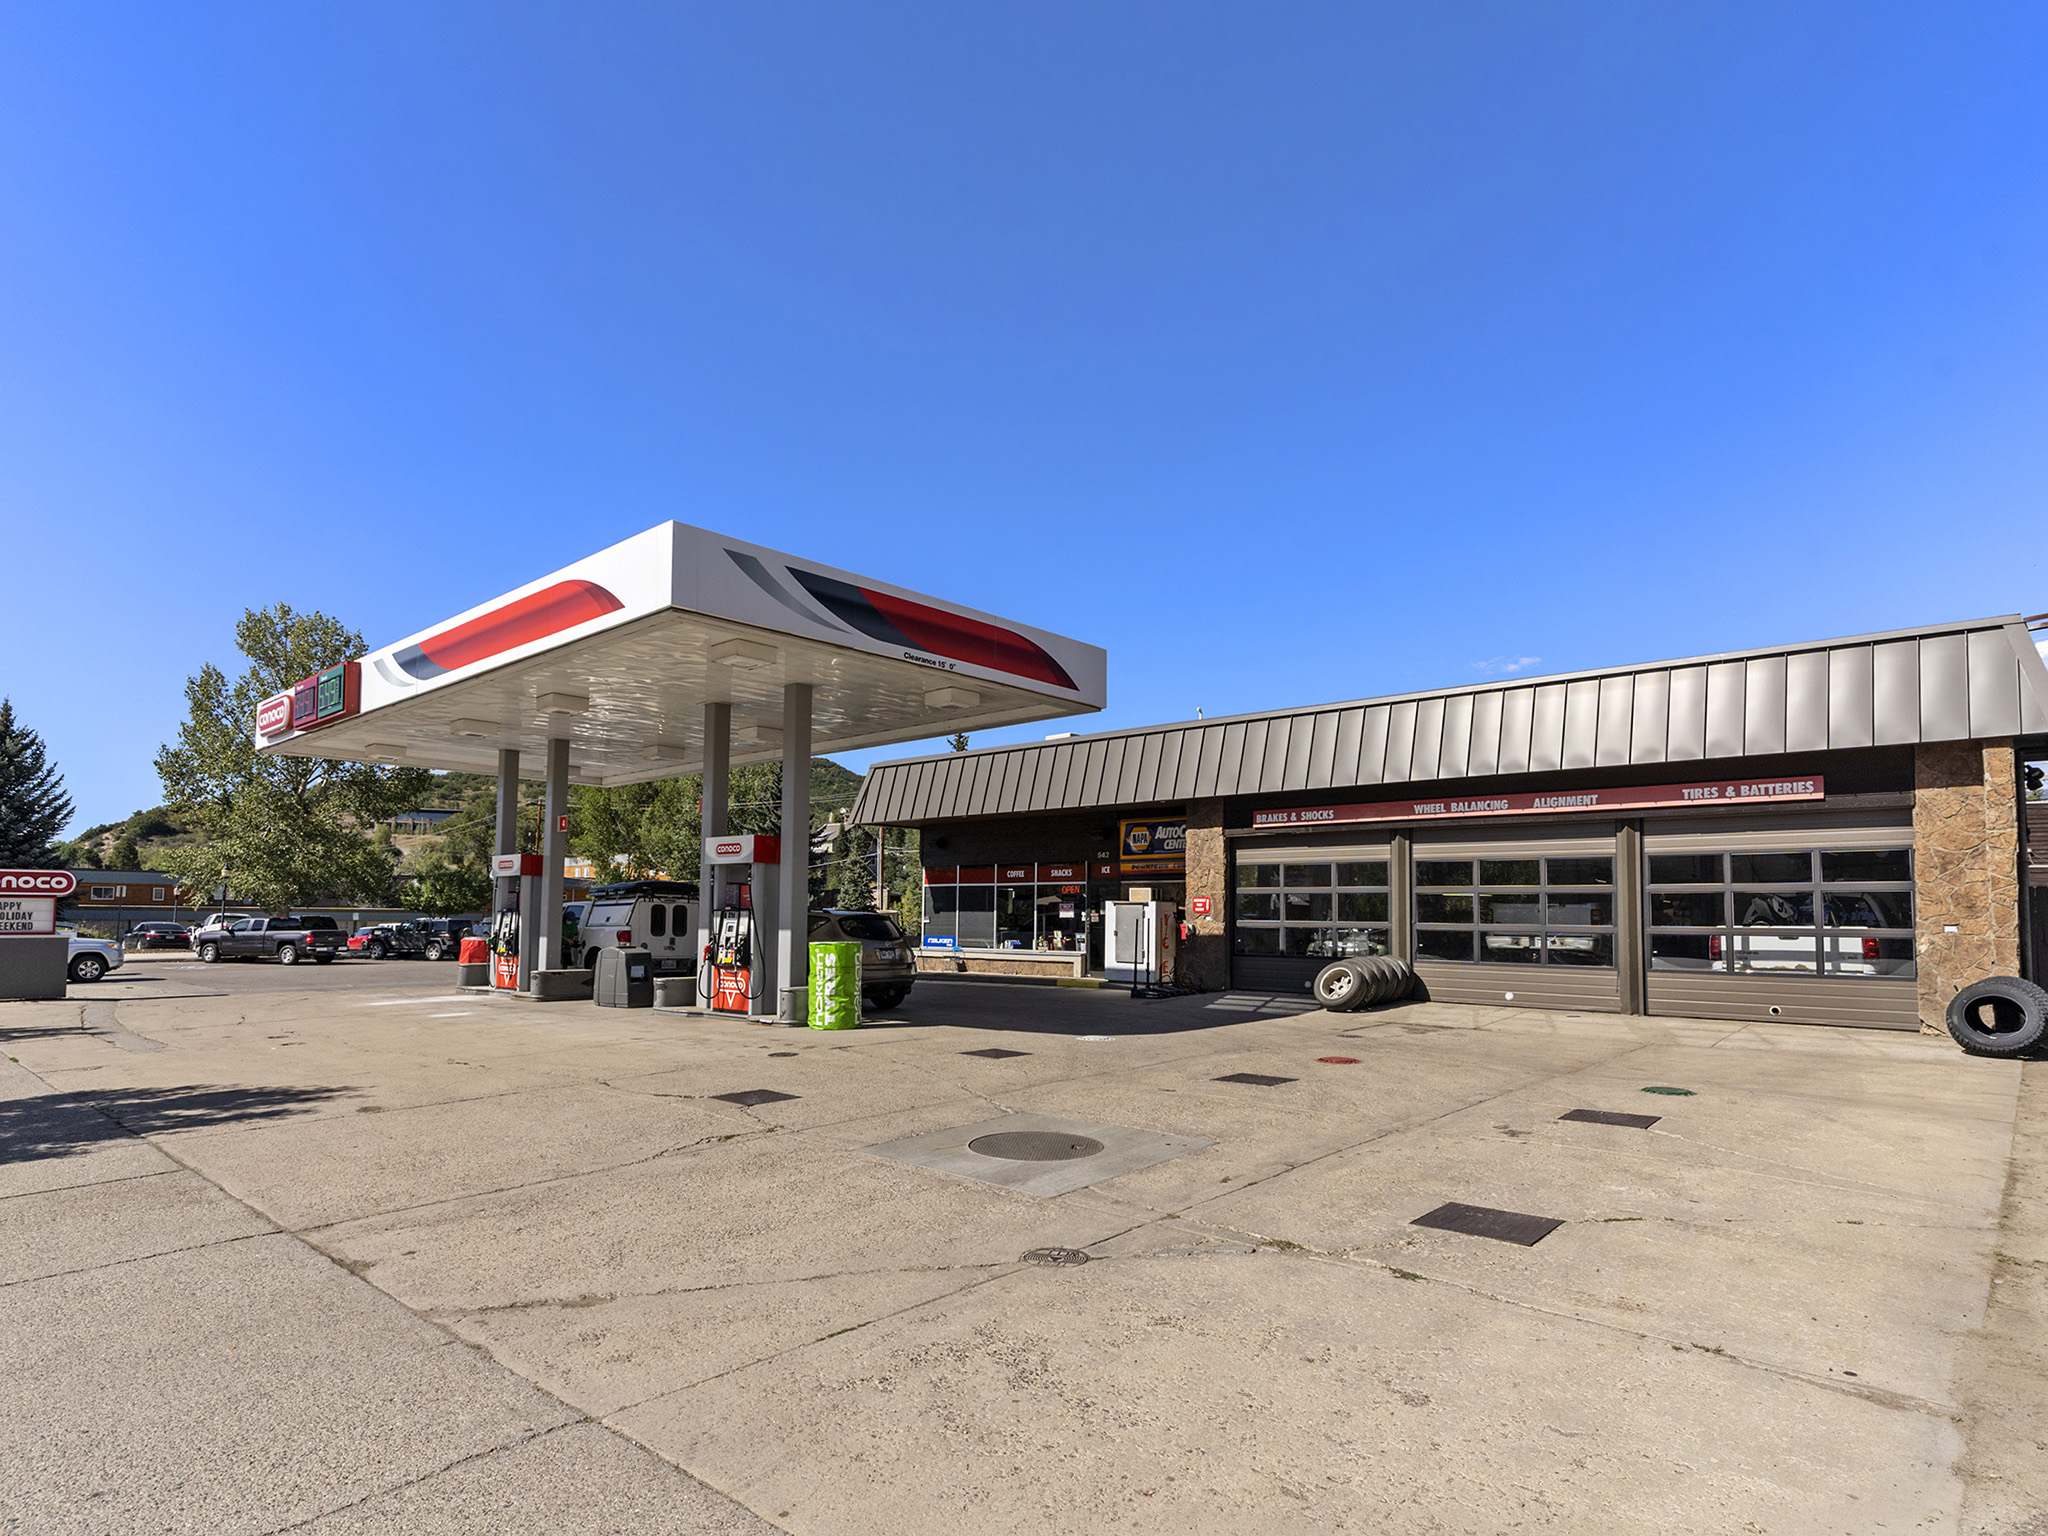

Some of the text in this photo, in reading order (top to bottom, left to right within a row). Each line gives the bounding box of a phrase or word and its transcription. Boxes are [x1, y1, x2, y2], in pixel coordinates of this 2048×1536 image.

[904, 651, 937, 666] Clearance
[1682, 781, 1815, 800] TIRES & BATTERIES
[1413, 799, 1509, 814] WHEEL BALANCING
[1533, 794, 1599, 808] ALIGNMENT
[1256, 810, 1334, 823] BRAKES & SHOCKS
[1131, 832, 1149, 845] NAPA
[1007, 870, 1025, 878] COFFEE
[1051, 869, 1072, 877] SNACKS
[1101, 866, 1111, 874] ICE
[1061, 885, 1080, 894] OPEN
[824, 953, 836, 1026] TYRES
